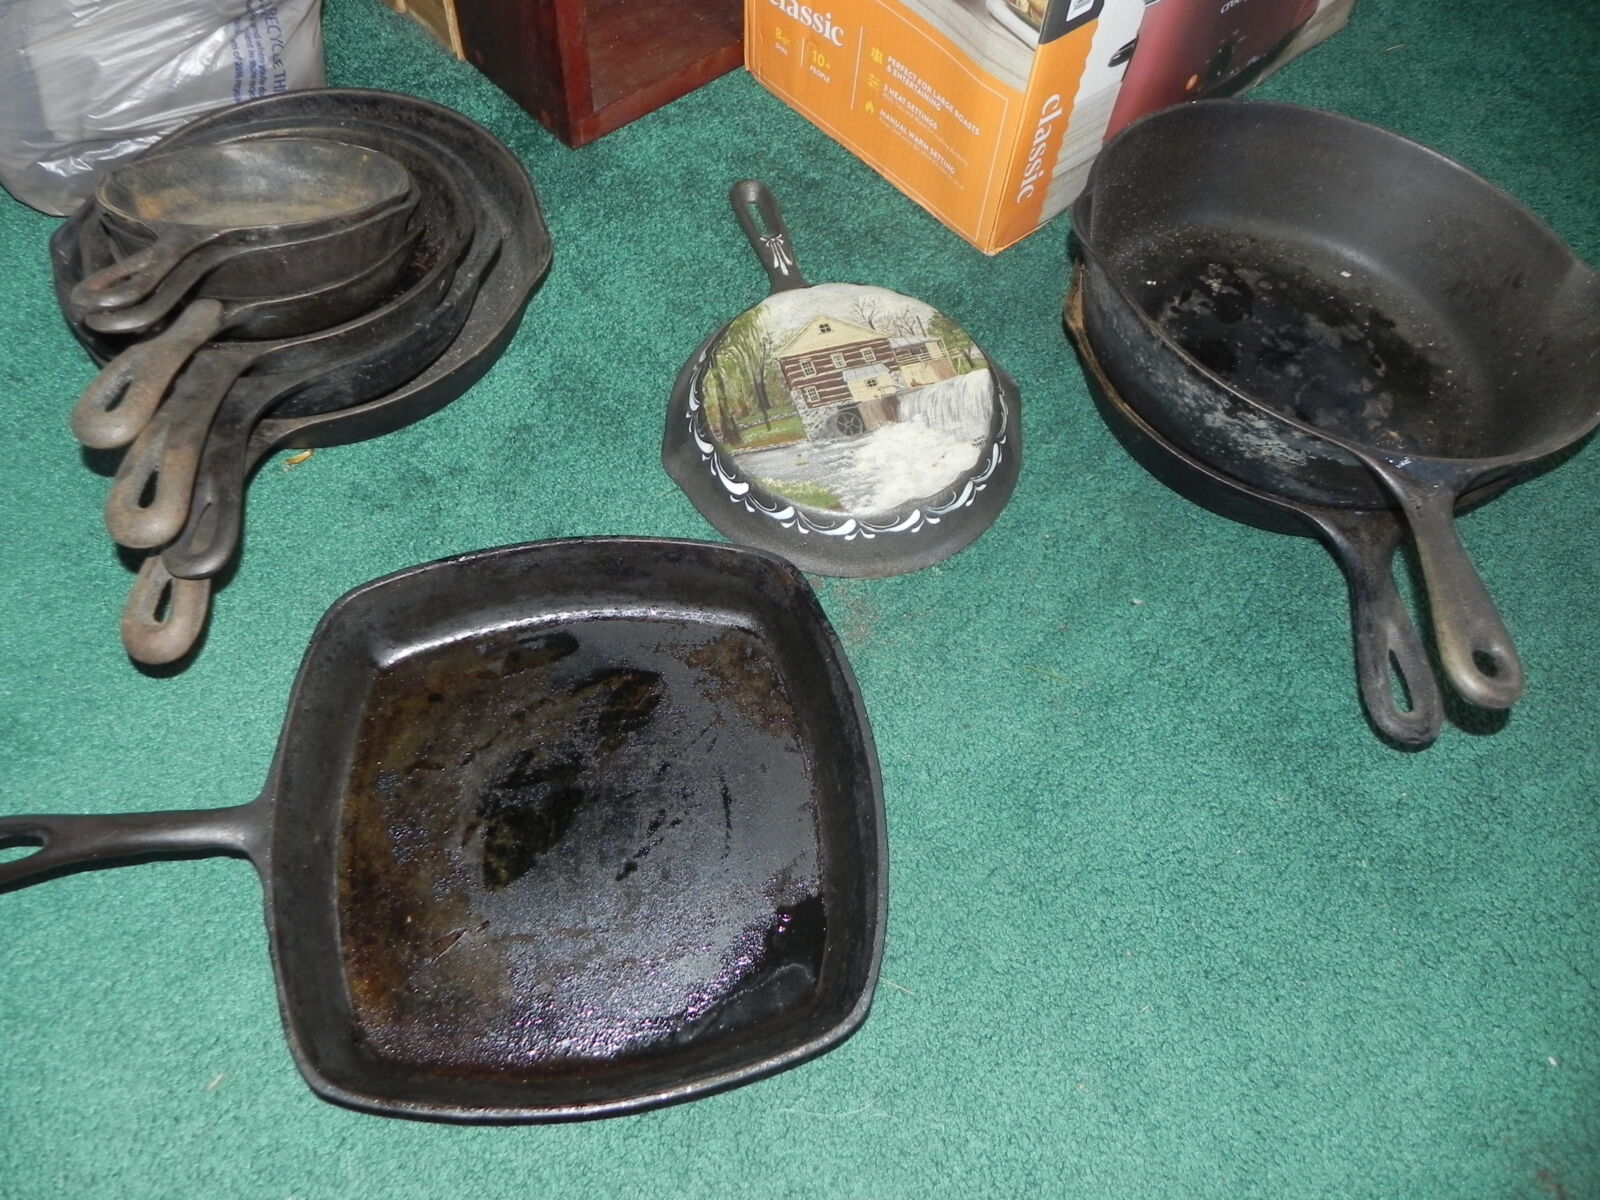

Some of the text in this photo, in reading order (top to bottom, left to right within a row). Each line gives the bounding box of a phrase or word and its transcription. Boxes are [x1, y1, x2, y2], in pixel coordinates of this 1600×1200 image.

[263, 7, 287, 93] RECYCLE THI
[809, 65, 830, 84] PEOPLE
[886, 64, 942, 112] & ENTERTAINING
[887, 55, 980, 136] PERFECT FOR LARGE ROASTS
[888, 87, 907, 104] HEAT
[907, 101, 938, 130] SETTINGS
[879, 108, 956, 175] MANUAL WARM SETTING
[1017, 93, 1063, 204] classic
